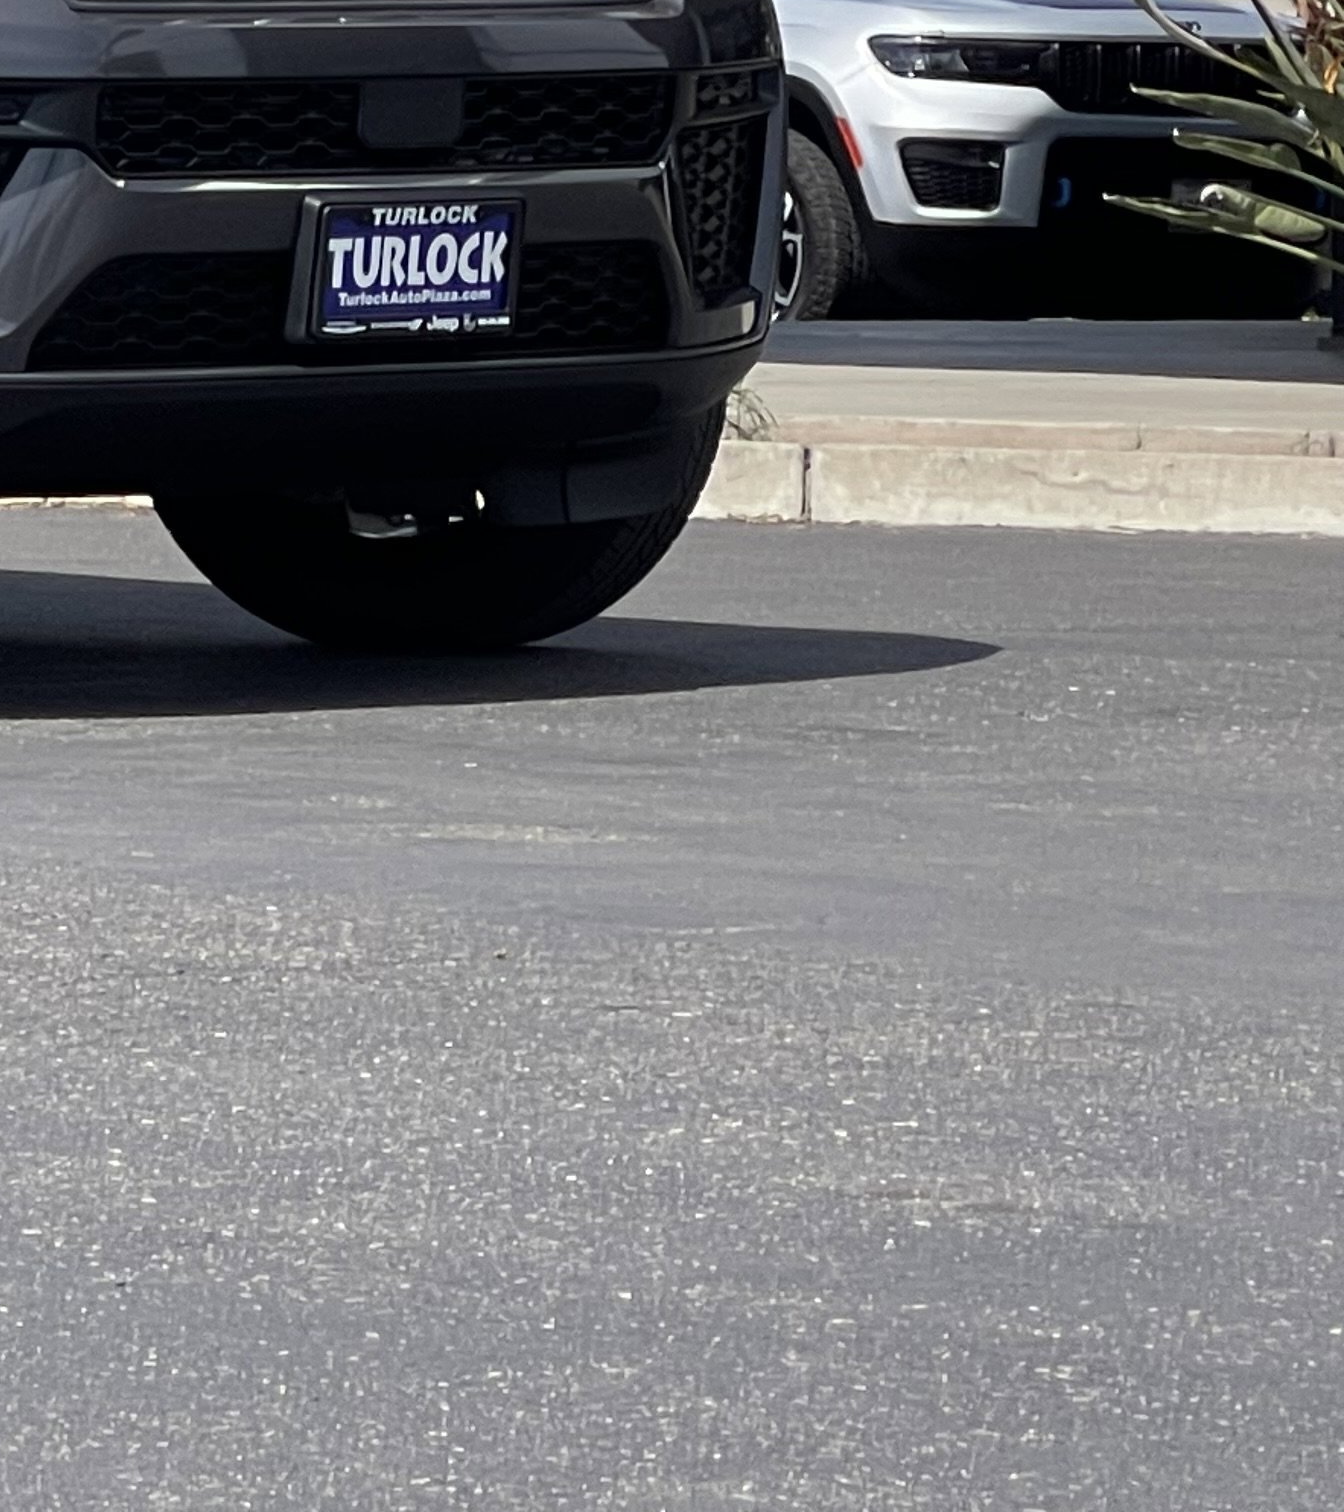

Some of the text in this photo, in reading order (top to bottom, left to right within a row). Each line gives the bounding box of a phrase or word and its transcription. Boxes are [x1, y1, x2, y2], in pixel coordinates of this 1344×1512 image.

[372, 204, 479, 226] TURLOCK
[328, 231, 508, 289] TURLOCK
[338, 289, 491, 307] TurlockAutoPlaza.com
